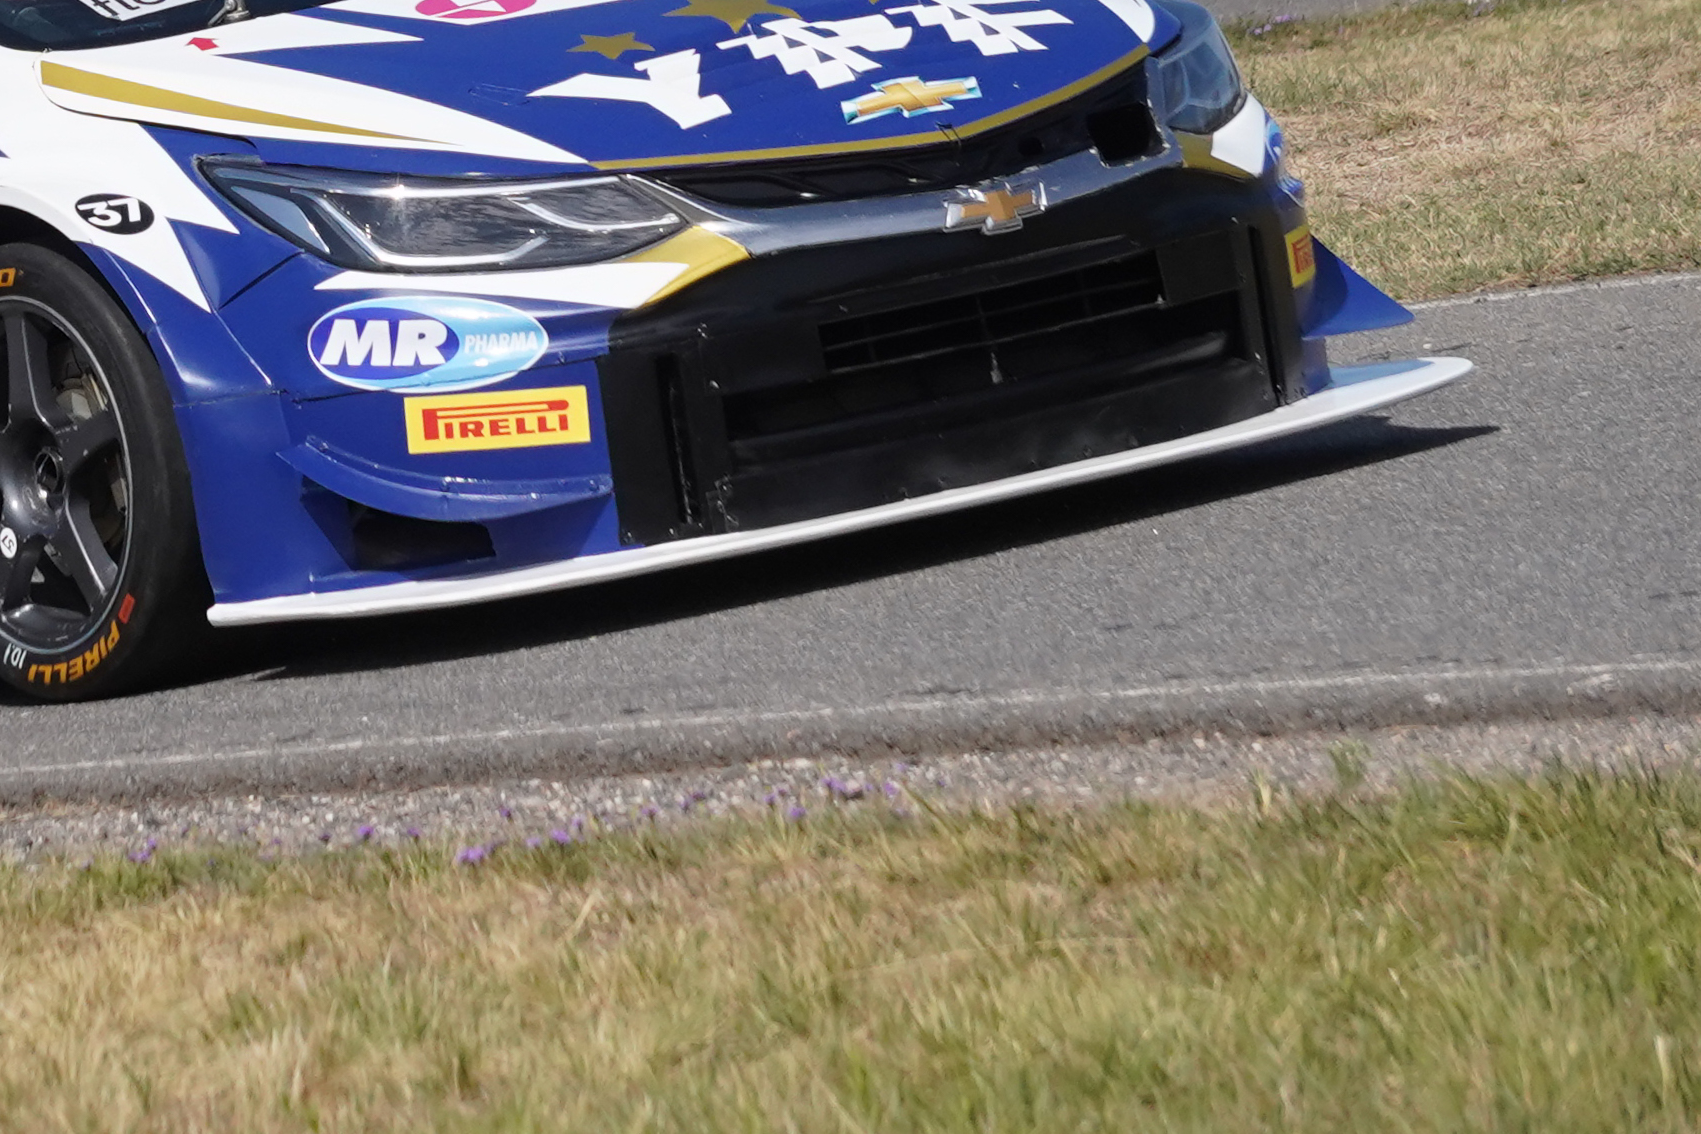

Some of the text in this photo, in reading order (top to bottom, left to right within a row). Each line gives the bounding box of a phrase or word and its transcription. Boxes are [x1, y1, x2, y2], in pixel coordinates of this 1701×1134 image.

[81, 197, 146, 229] 37
[319, 319, 539, 368] MR PHARMA
[423, 399, 570, 442] PIRELLI
[27, 619, 121, 685] PIRELLI
